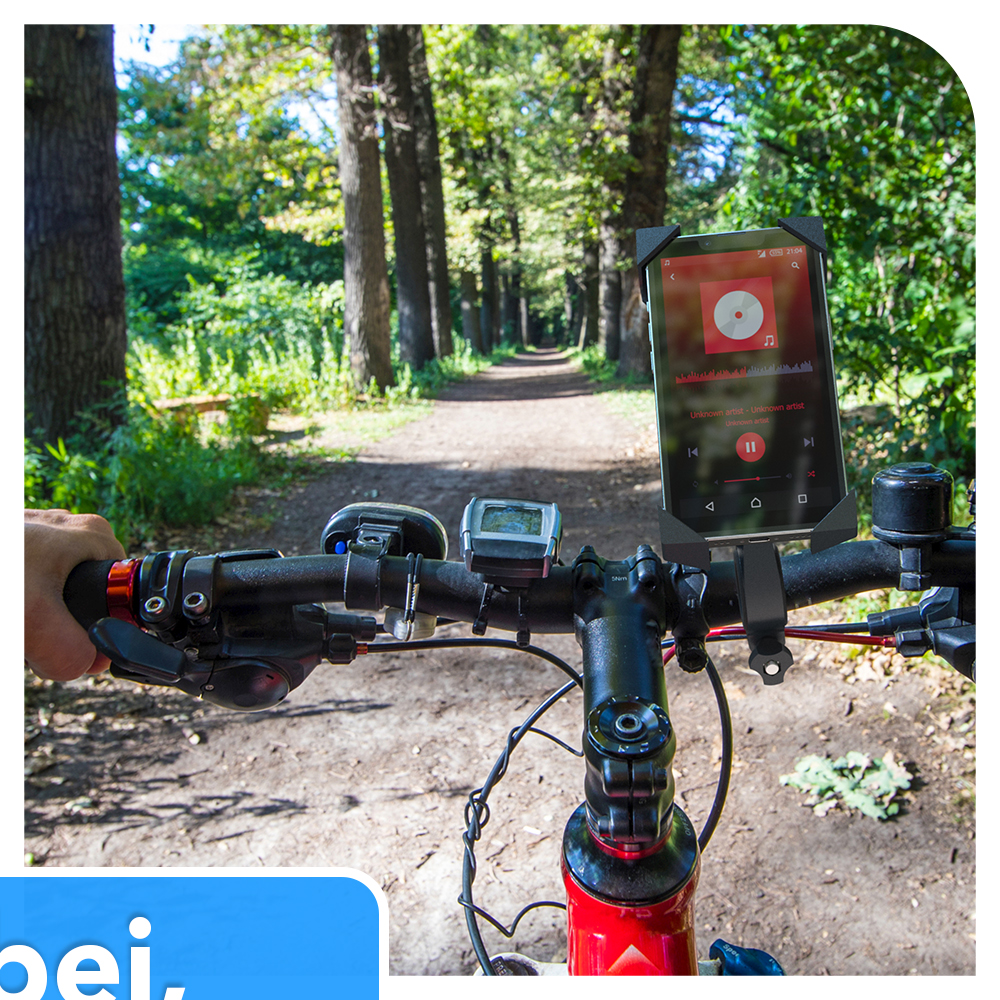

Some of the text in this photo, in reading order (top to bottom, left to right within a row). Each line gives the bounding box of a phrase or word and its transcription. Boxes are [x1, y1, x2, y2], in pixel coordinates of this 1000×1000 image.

[786, 247, 802, 255] 21:04
[690, 410, 724, 419] Unknown
[725, 407, 744, 416] artist
[750, 404, 784, 414] Unknown
[786, 402, 805, 410] artist
[725, 419, 753, 427] Unknown
